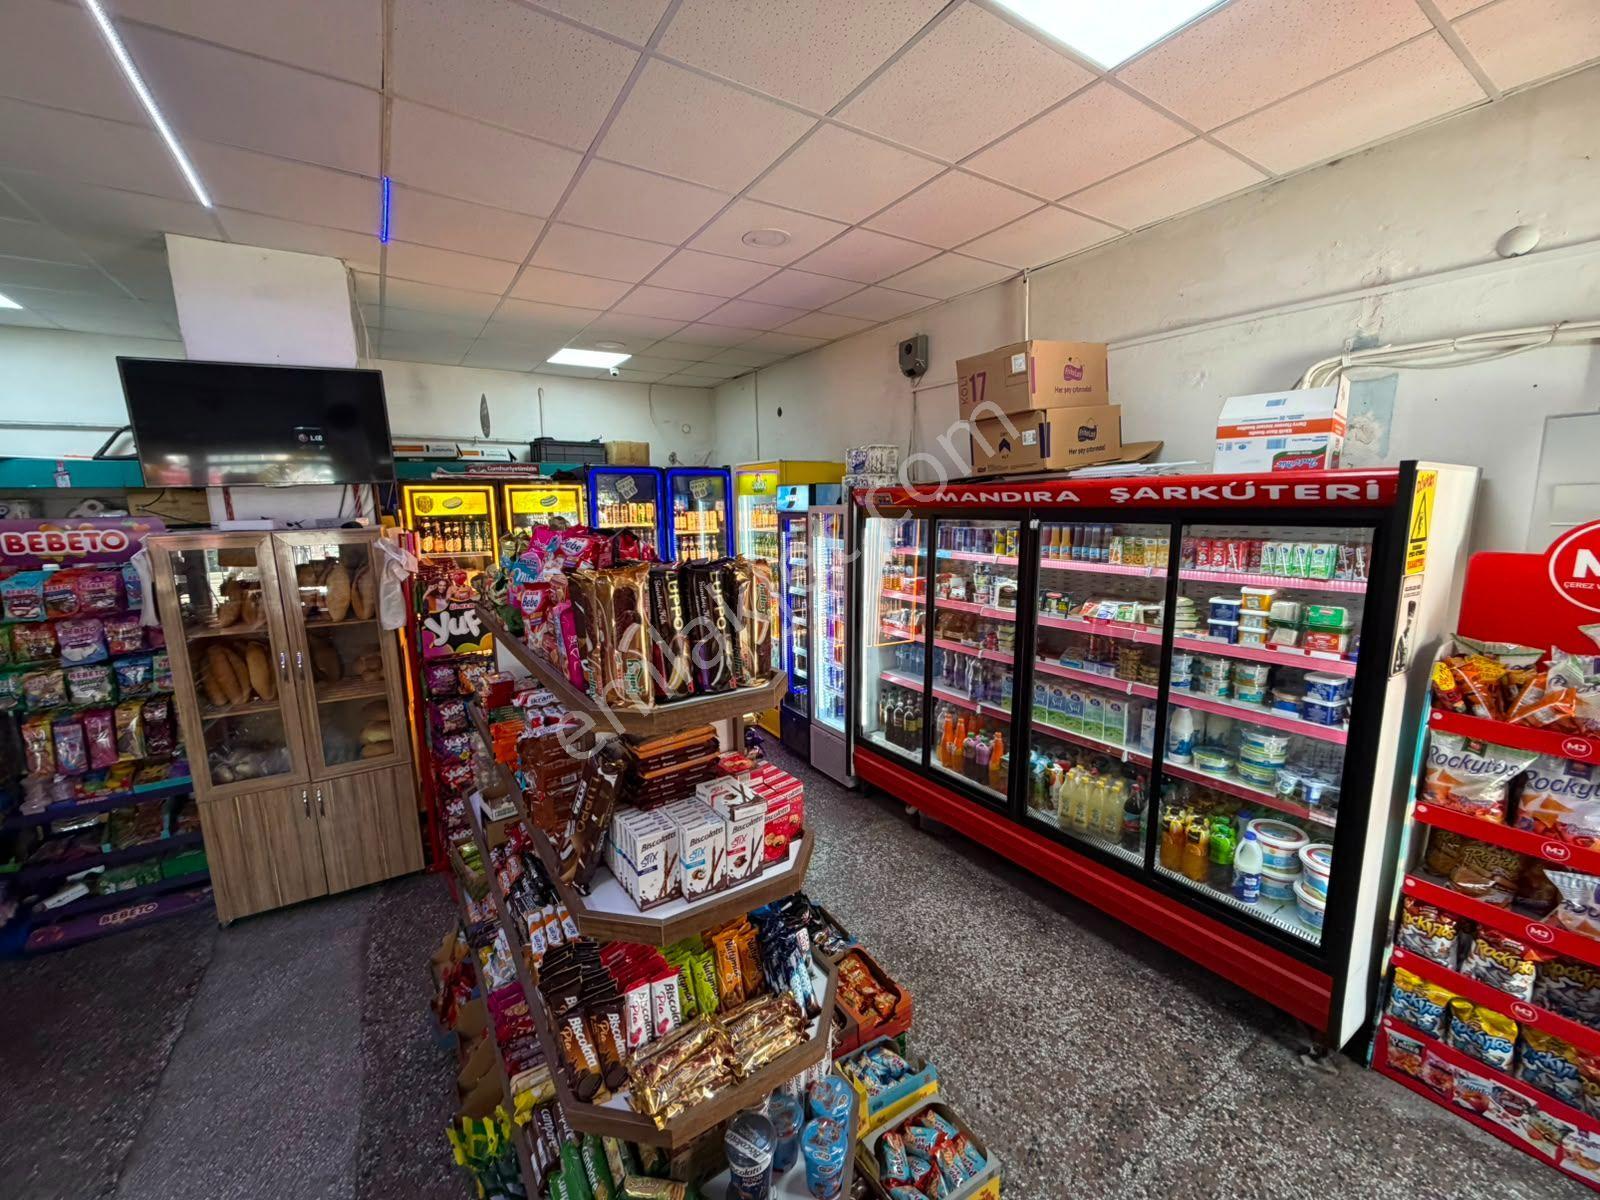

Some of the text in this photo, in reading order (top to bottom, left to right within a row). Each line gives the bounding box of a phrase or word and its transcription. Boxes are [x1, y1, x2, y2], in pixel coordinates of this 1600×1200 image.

[969, 372, 986, 402] 17
[487, 464, 537, 473] Cumhuriyetimizin
[936, 479, 1381, 504] MANDIRA ŞARKÜTERİ
[2, 531, 128, 555] BEBETO
[1564, 581, 1595, 589] ÇEREZ
[523, 596, 539, 608] Bebe
[666, 572, 684, 631] LUPPO
[1428, 745, 1520, 777] Rockytos
[732, 814, 764, 834] Biscolata
[765, 805, 790, 822] iscolata
[641, 831, 677, 852] Biscolata
[689, 826, 724, 847] Biscolata
[100, 903, 157, 925] BEBETO
[568, 1017, 597, 1068] Biscolata
